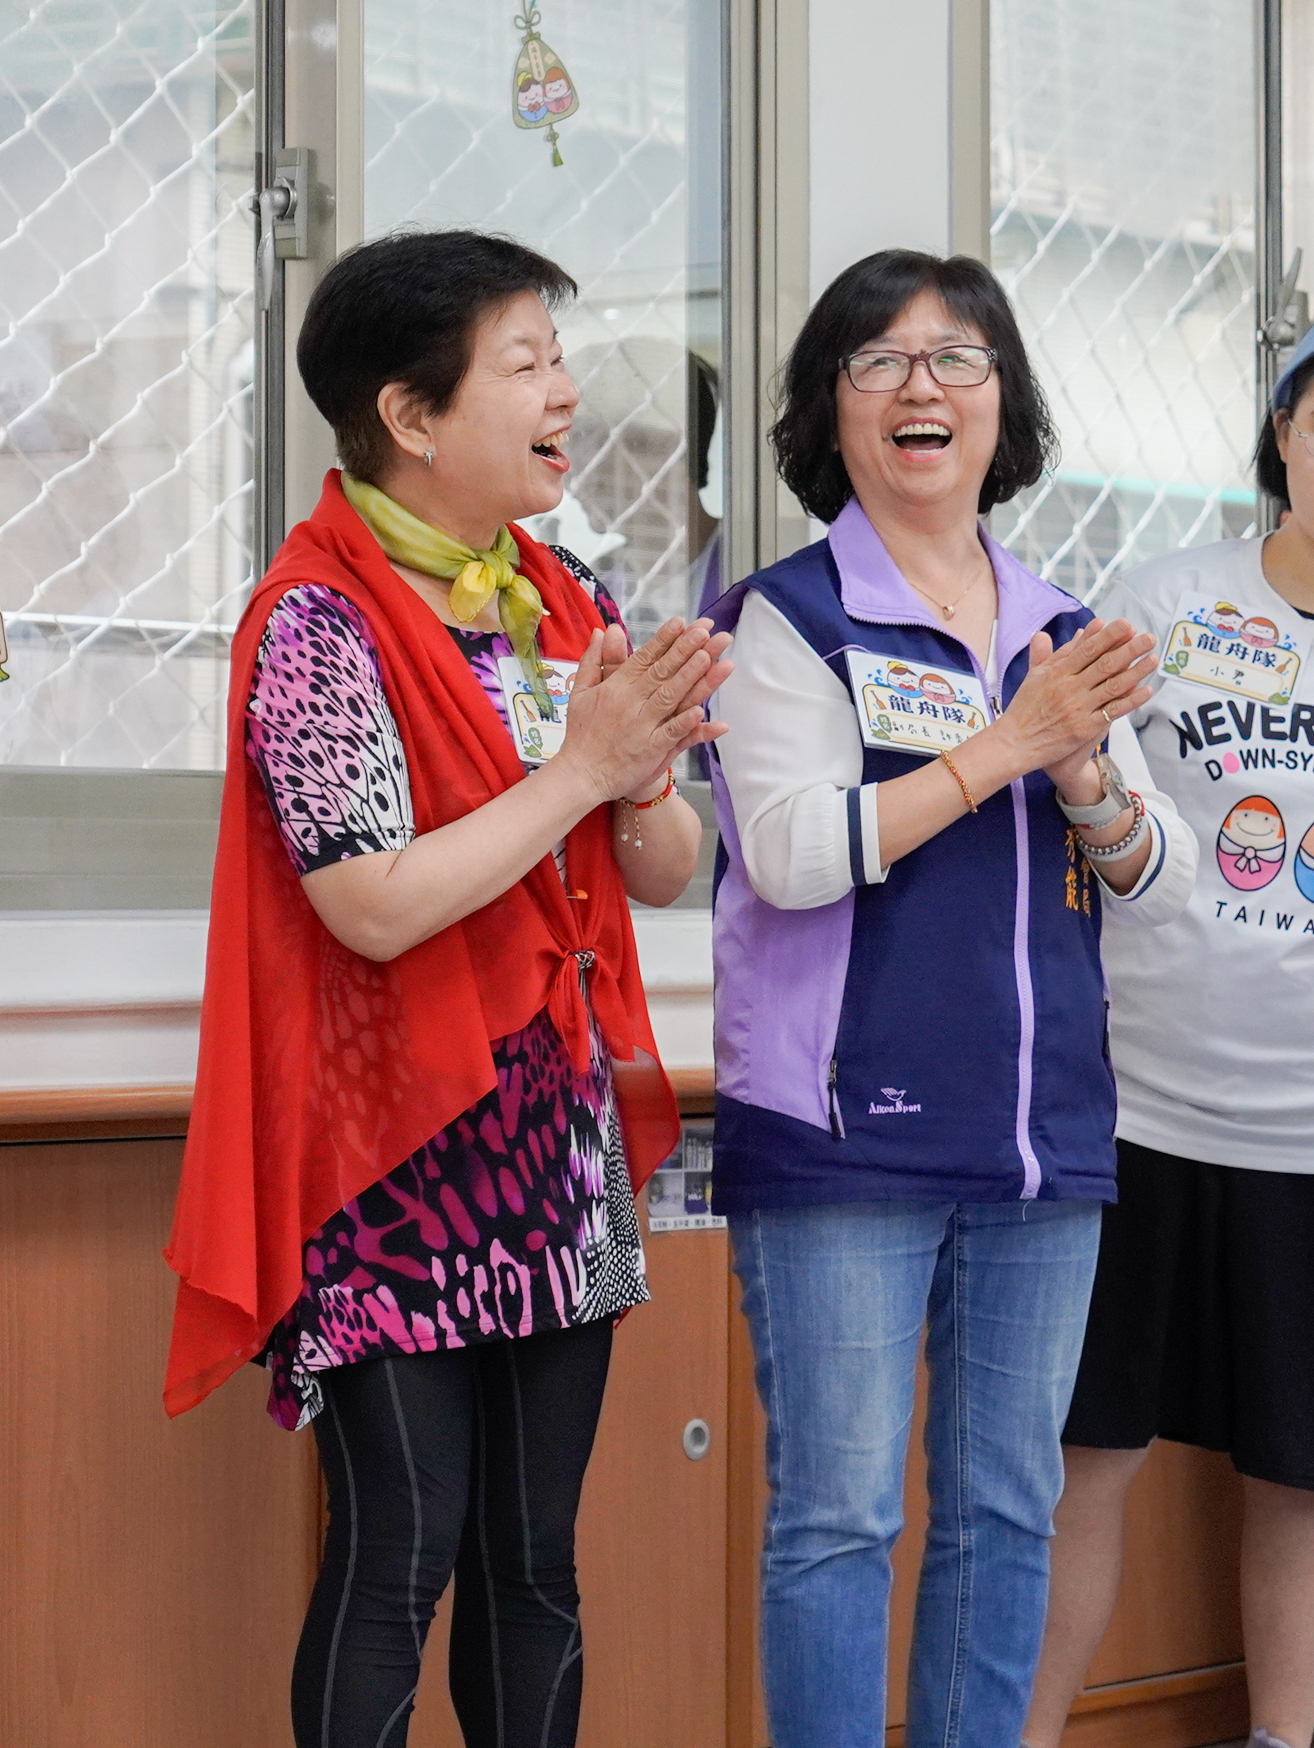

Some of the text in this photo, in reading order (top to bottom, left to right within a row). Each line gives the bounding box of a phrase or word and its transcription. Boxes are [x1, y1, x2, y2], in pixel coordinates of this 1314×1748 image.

[1196, 633, 1277, 668] 龍舟隊
[887, 694, 966, 724] 龍舟隊
